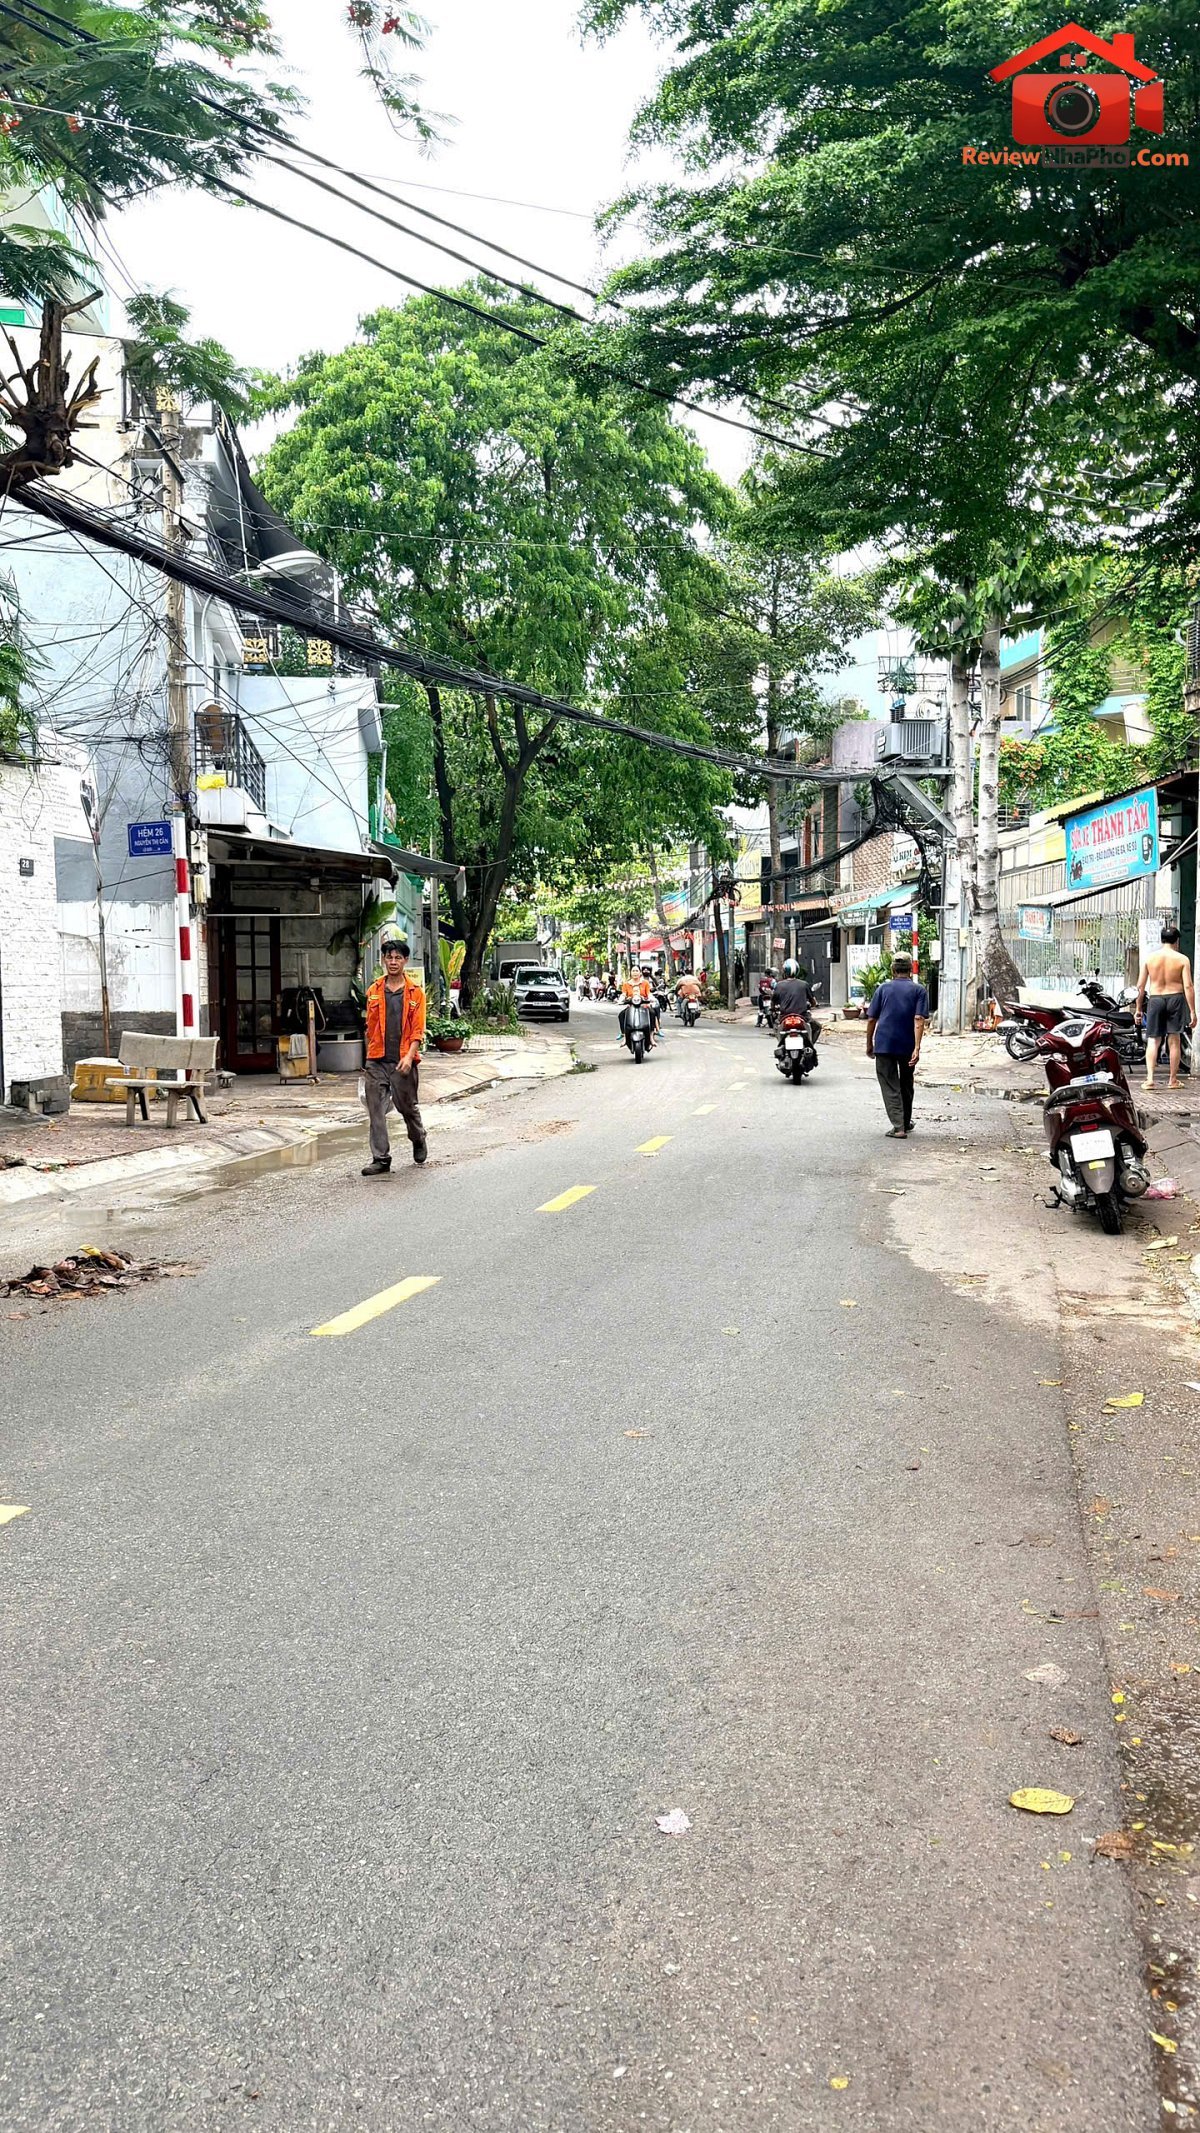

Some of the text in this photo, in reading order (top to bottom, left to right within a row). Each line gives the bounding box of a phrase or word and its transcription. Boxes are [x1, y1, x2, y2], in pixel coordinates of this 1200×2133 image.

[1091, 808, 1125, 846] THÀNH
[1126, 796, 1149, 833] TÂM
[154, 827, 164, 837] 26
[21, 859, 30, 868] 28
